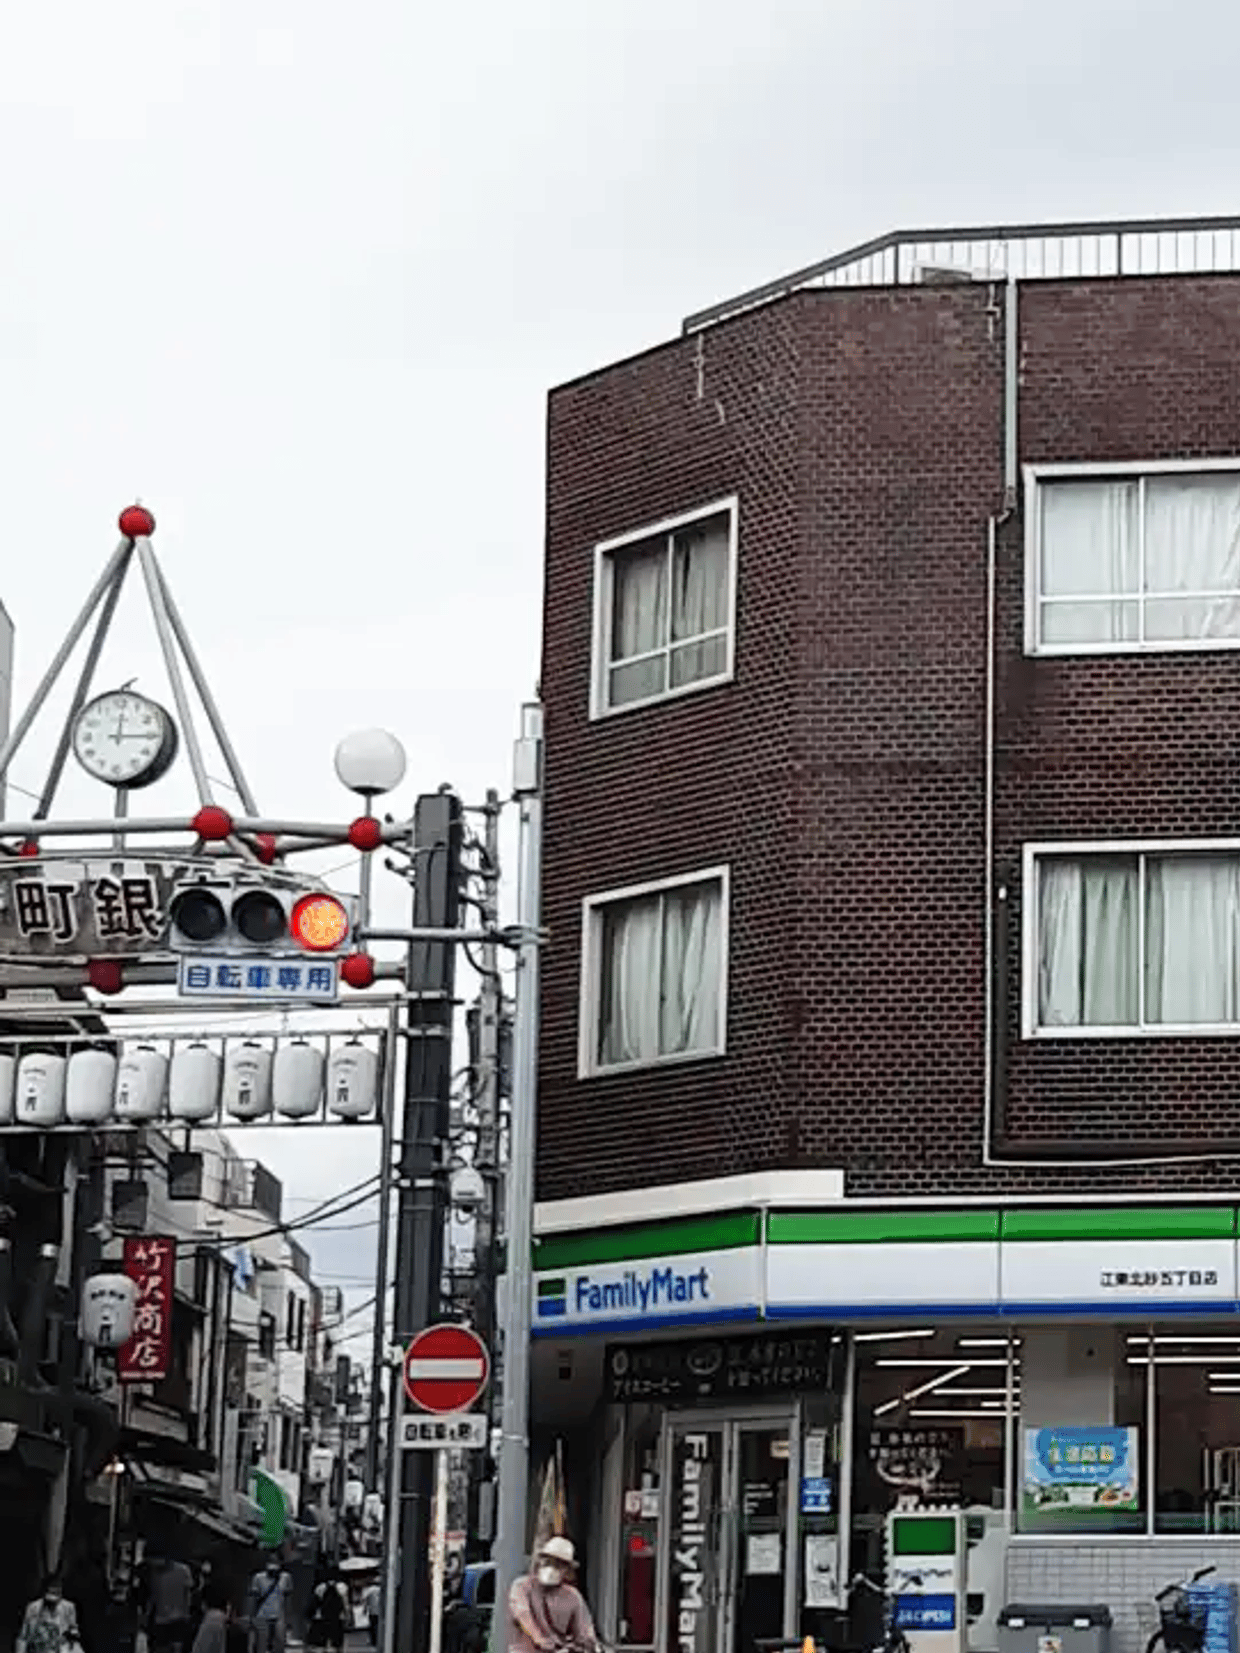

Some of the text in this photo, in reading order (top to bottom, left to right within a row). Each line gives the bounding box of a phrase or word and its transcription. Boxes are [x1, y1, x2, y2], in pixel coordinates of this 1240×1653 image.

[187, 965, 331, 992] 自転車専用
[576, 1266, 709, 1313] FamilyMart
